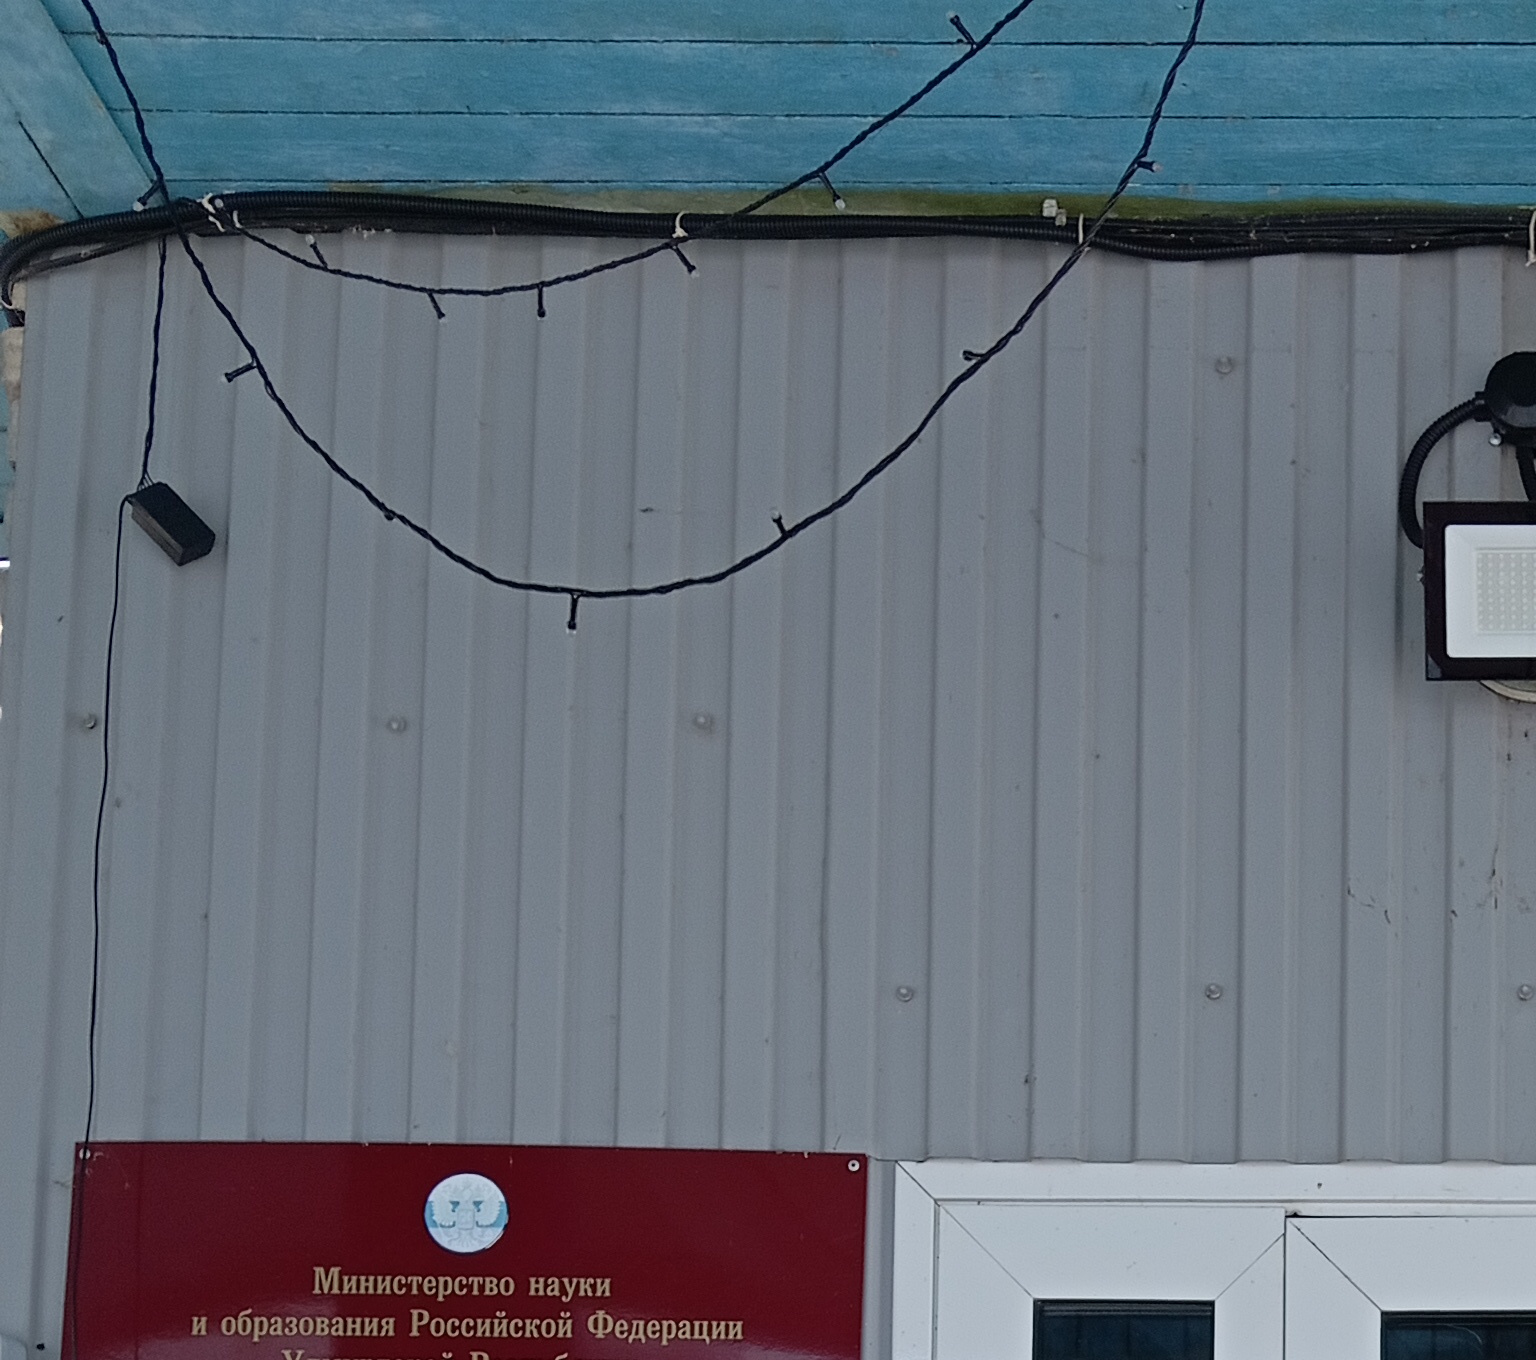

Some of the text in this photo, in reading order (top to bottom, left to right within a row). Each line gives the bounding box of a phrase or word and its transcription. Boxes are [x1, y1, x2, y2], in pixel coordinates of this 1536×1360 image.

[312, 1267, 611, 1302] Министерство науки
[192, 1309, 743, 1345] и образования Российской Федерации
